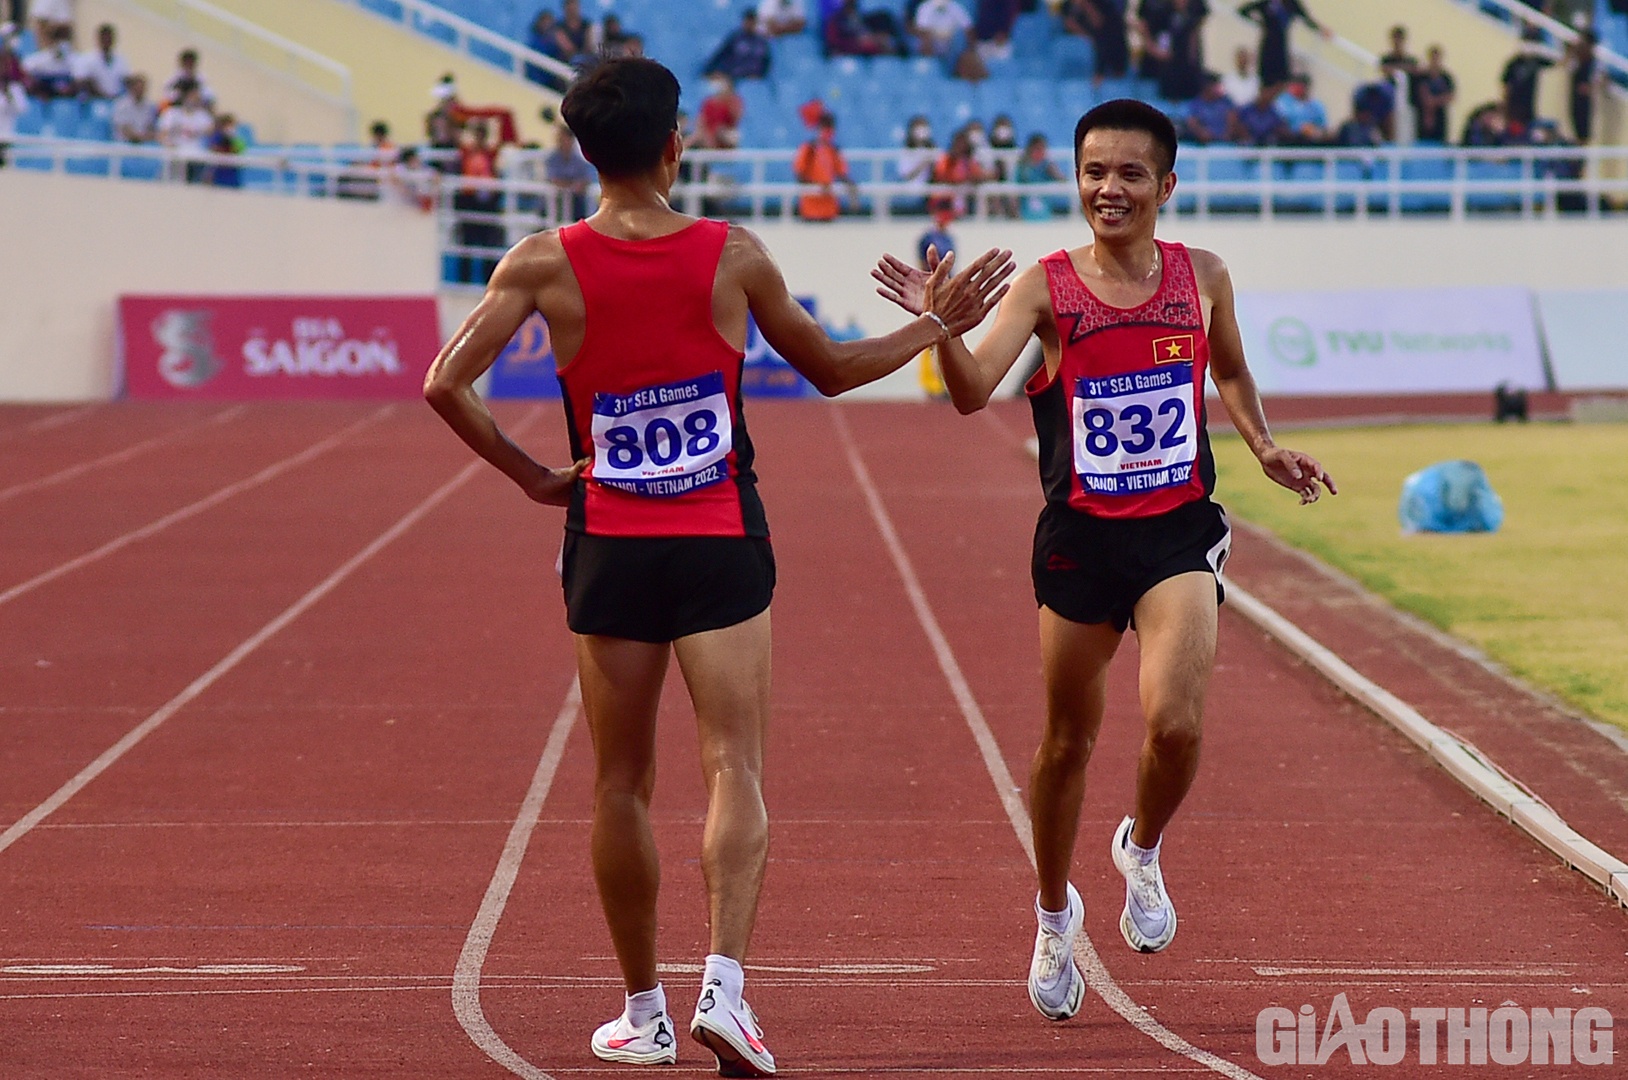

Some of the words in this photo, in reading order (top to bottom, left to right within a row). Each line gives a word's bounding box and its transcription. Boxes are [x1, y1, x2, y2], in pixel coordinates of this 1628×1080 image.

[243, 338, 402, 376] SAIGON
[1110, 376, 1133, 393] SEA
[1135, 371, 1172, 389] Games
[634, 389, 658, 407] SEA
[659, 384, 698, 403] Games
[604, 409, 720, 470] 808
[1083, 397, 1187, 457] 832
[1120, 459, 1162, 470] VIETNAM
[646, 477, 693, 494] VIETNAM
[695, 466, 719, 486] 2022
[1126, 470, 1170, 490] VIETNAM
